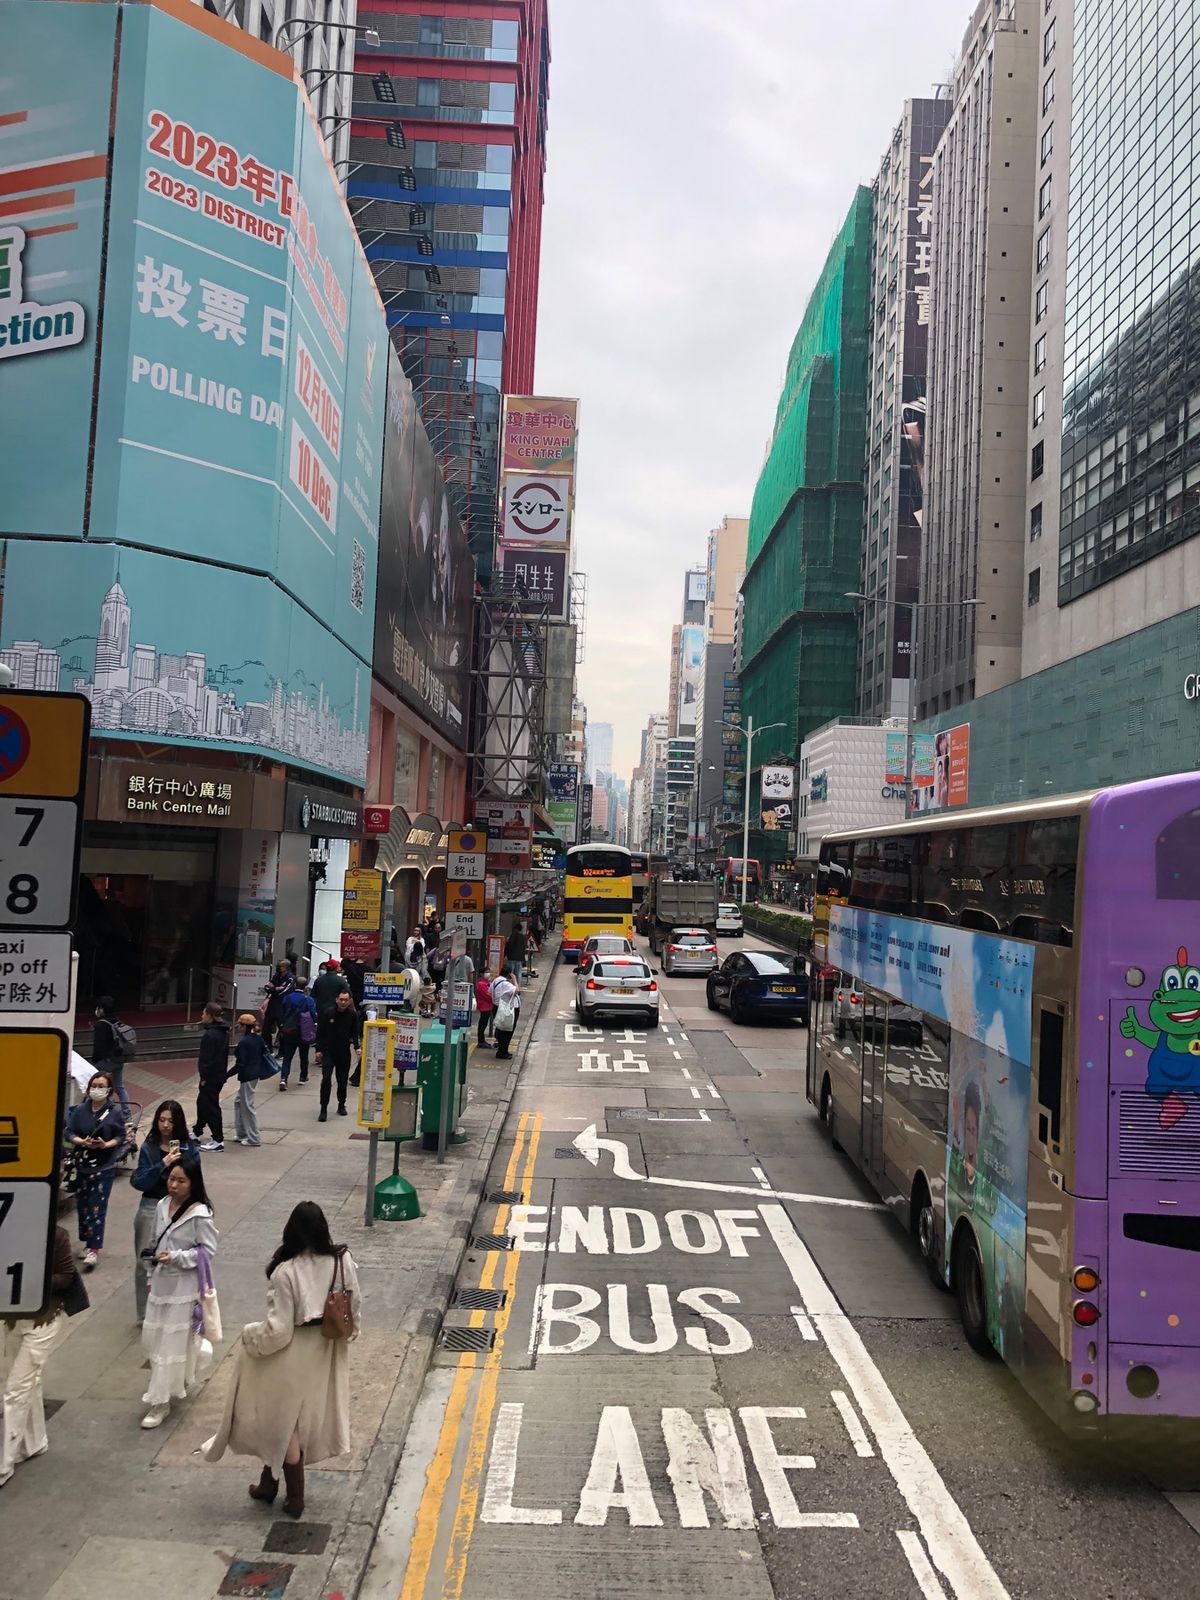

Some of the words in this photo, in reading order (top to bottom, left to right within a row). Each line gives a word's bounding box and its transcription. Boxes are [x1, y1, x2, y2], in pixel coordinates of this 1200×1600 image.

[148, 171, 198, 208] 2023
[204, 196, 286, 247] DISTRICT
[136, 255, 289, 366] 投票日
[132, 355, 243, 416] POLLING
[510, 433, 541, 446] KING
[542, 436, 570, 448] WAH
[518, 447, 563, 460] CENTRE
[298, 438, 311, 494] 10
[509, 501, 566, 517] スシロー
[128, 775, 233, 801] 銀行中心廣場
[127, 798, 158, 812] Bank
[162, 800, 203, 814] Centre
[207, 803, 232, 817] Mall
[312, 803, 341, 823] STARBUCKS
[341, 809, 358, 826] COFFEE
[454, 866, 479, 878] 終止
[458, 856, 476, 864] End
[6, 874, 39, 915] 8
[456, 915, 474, 923] End
[21, 959, 49, 975] off
[577, 1049, 650, 1073] 站
[506, 1204, 662, 1255] END
[664, 1206, 761, 1258] OF
[528, 1283, 754, 1356] BUS
[481, 1402, 860, 1530] LANE
